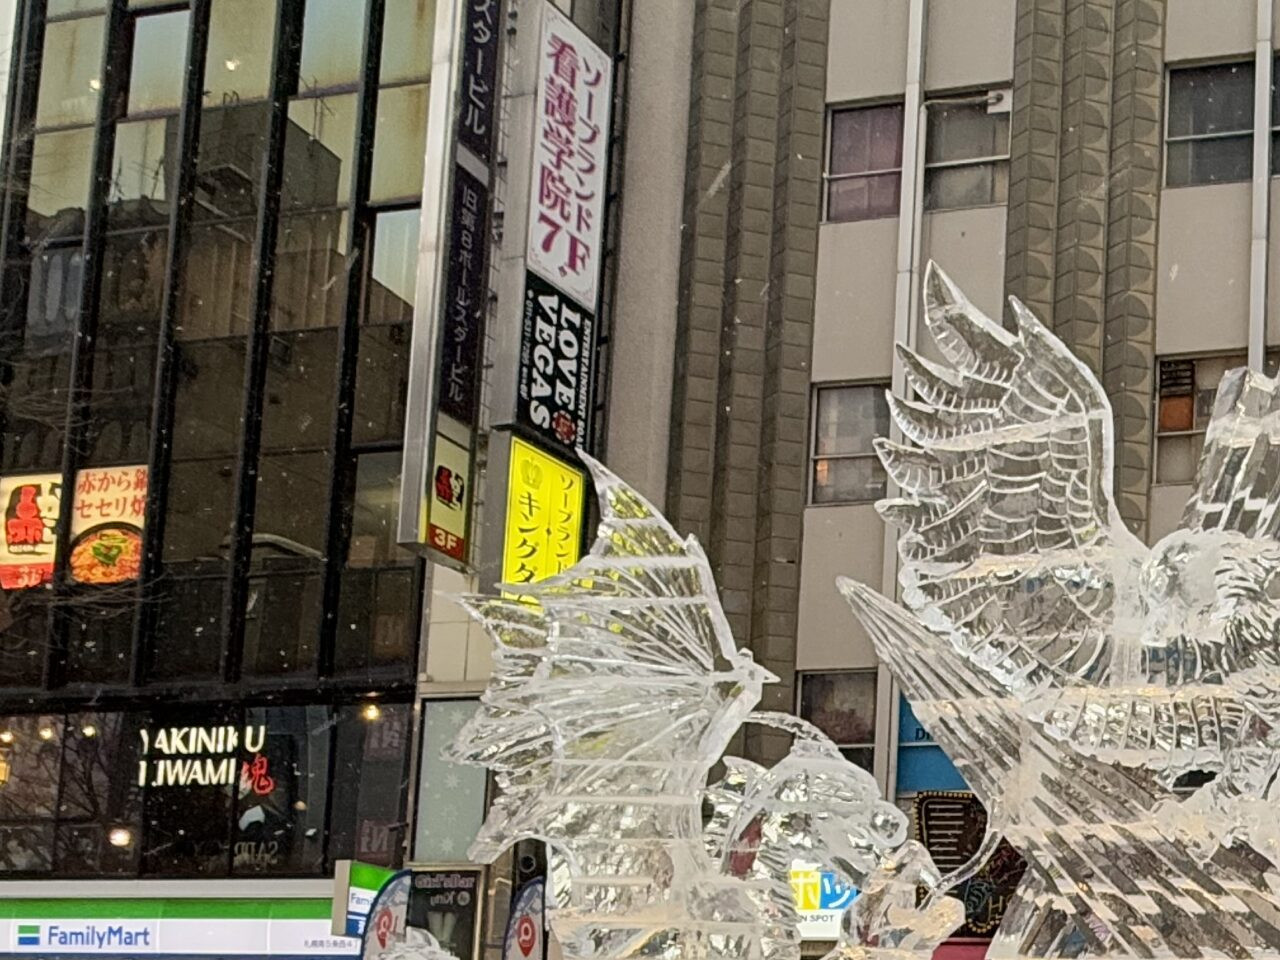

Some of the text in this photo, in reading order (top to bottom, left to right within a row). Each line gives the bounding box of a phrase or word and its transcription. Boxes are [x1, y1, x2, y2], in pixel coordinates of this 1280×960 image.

[539, 33, 579, 222] 看護学院
[574, 57, 602, 233] ソープランド
[529, 295, 559, 429] VEGAS
[554, 303, 581, 411] LOVE
[434, 528, 457, 550] 3F
[48, 926, 150, 948] FamilyMart
[810, 914, 834, 922] SPOT
